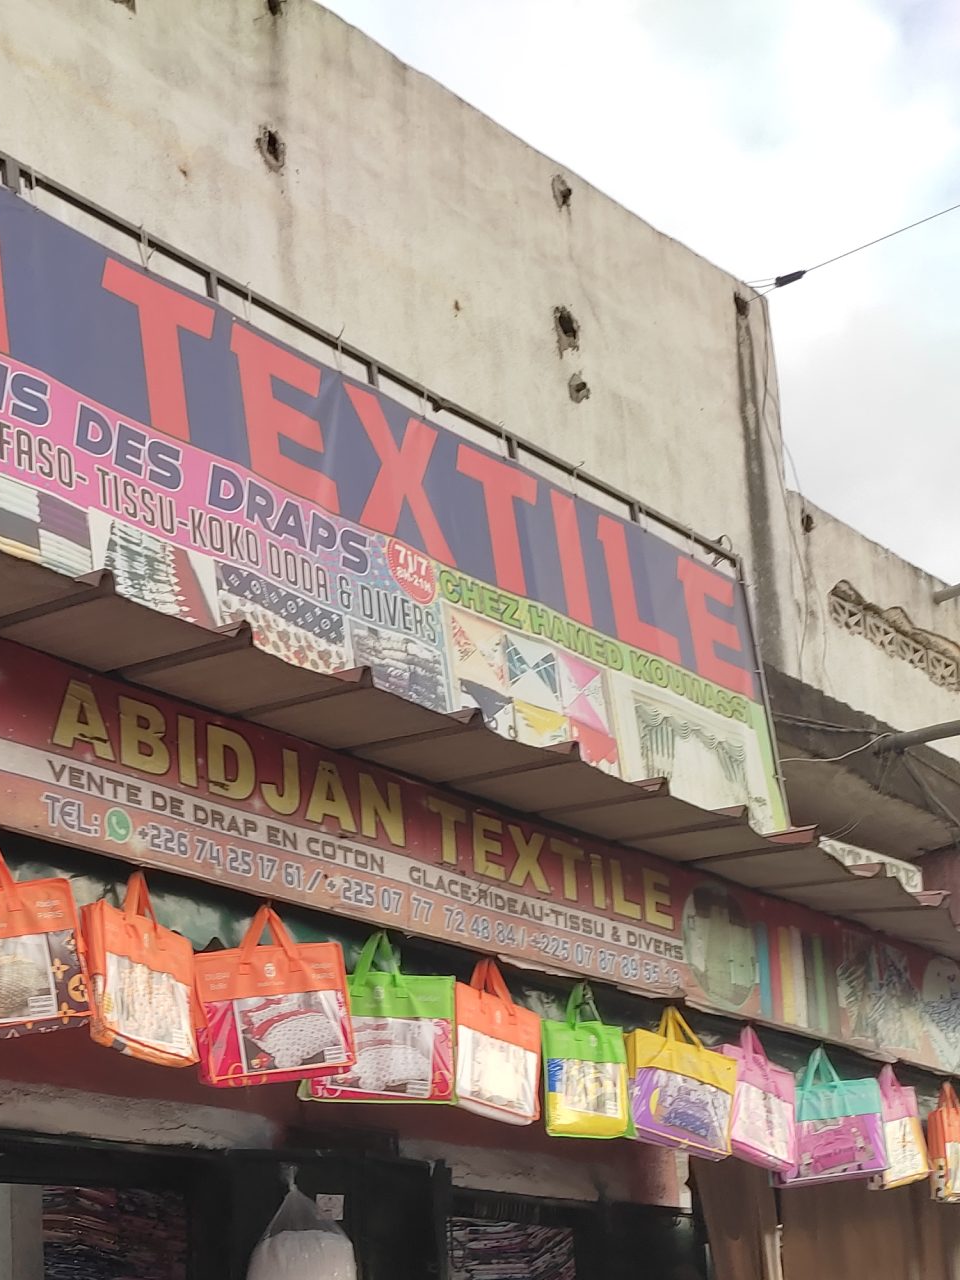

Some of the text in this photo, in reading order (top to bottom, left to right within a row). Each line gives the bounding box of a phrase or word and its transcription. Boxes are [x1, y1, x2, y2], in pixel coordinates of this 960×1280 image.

[74, 401, 183, 492] DES
[207, 462, 371, 576] DRAPS
[101, 257, 755, 700] TEXTILE
[266, 541, 331, 603] DODA
[337, 574, 352, 612] &
[359, 583, 438, 645] DIVERS
[439, 569, 522, 629] CHEZ
[528, 604, 623, 671] HAMED
[47, 759, 143, 804] VENTE
[150, 790, 184, 818] DE
[193, 804, 258, 838] DRAP
[266, 825, 299, 851] EN
[306, 836, 386, 874] COTON
[611, 926, 622, 943] &
[626, 931, 684, 962] DIVERS
[52, 679, 676, 931] ABIDJAN TEXTILE
[137, 824, 189, 857] +226
[195, 837, 221, 867] 74
[227, 847, 253, 876] 25
[258, 855, 278, 881] 17
[284, 862, 303, 890] 61
[381, 888, 403, 914] 07
[412, 896, 434, 924] 77
[444, 906, 466, 933] 72
[470, 916, 491, 941] 48
[575, 943, 594, 967] 07
